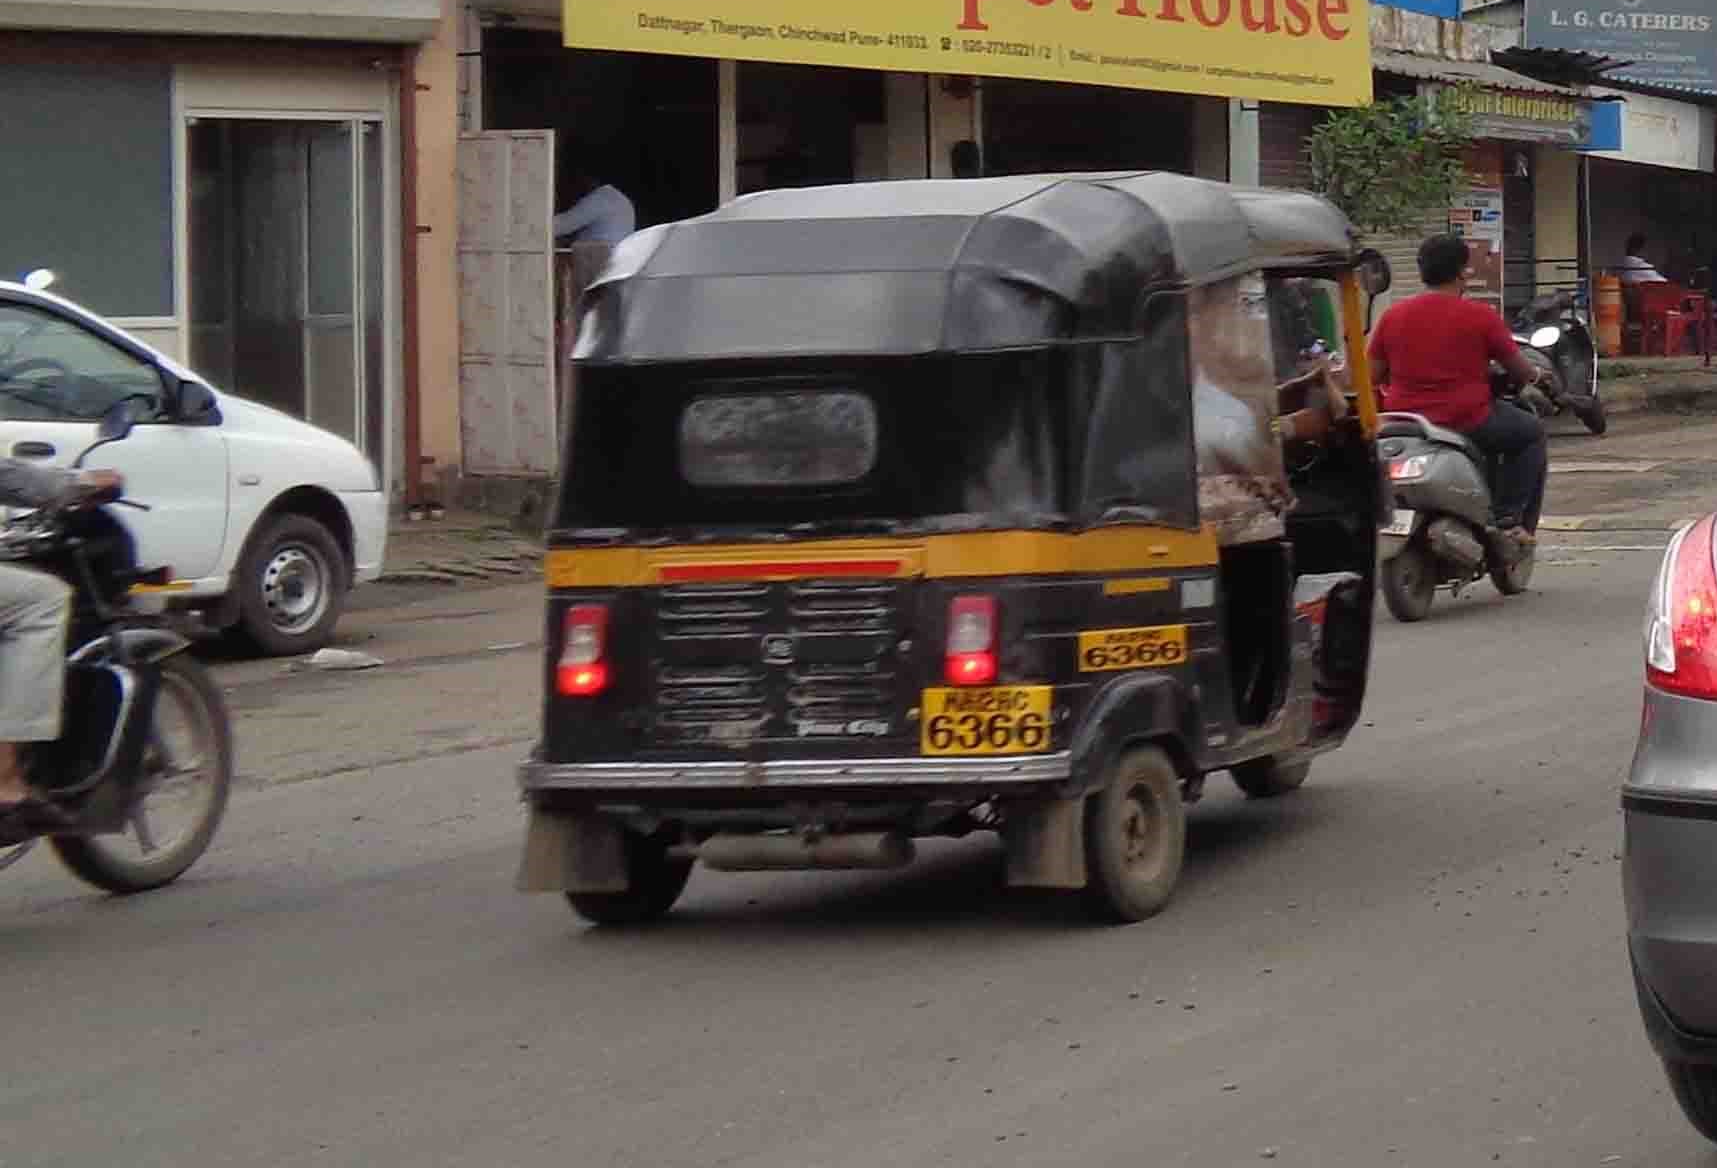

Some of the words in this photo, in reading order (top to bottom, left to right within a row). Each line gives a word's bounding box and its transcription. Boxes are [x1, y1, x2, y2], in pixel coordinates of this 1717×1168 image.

[778, 24, 847, 44] Chinchwad
[1599, 12, 1712, 32] CATERERS
[1495, 96, 1577, 121] Enterprises
[1086, 640, 1182, 668] 6366
[927, 712, 1045, 750] 6366
